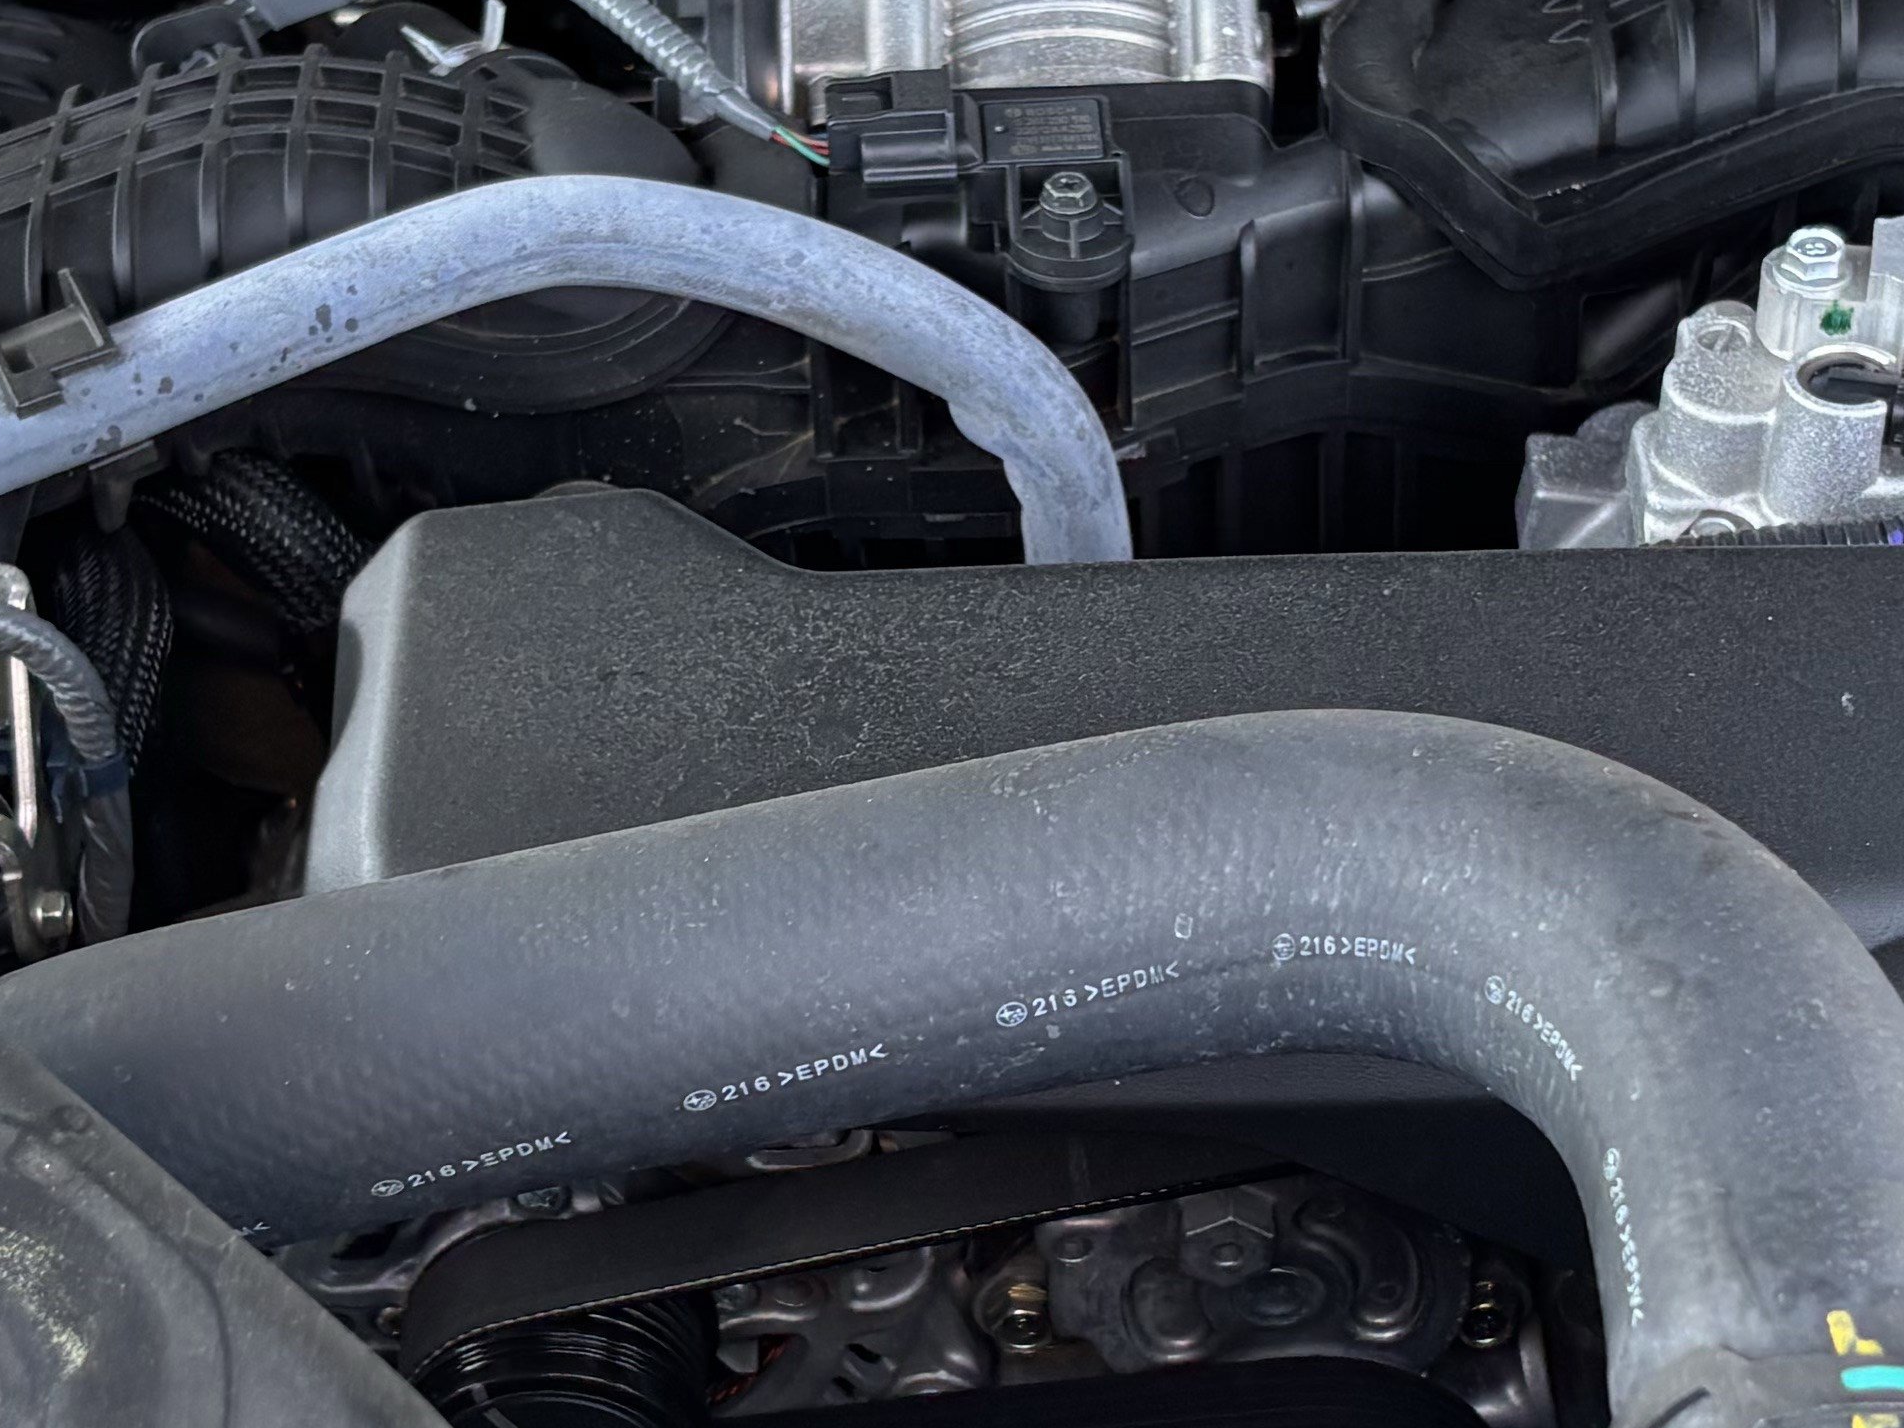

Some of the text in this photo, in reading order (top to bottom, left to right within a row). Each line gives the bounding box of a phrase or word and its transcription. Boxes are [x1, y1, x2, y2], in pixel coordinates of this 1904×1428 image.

[1299, 935, 1336, 958] 216
[1032, 989, 1077, 1017] 216
[1505, 990, 1536, 1024] 216
[722, 1075, 771, 1102] 216
[407, 1163, 457, 1189] 216
